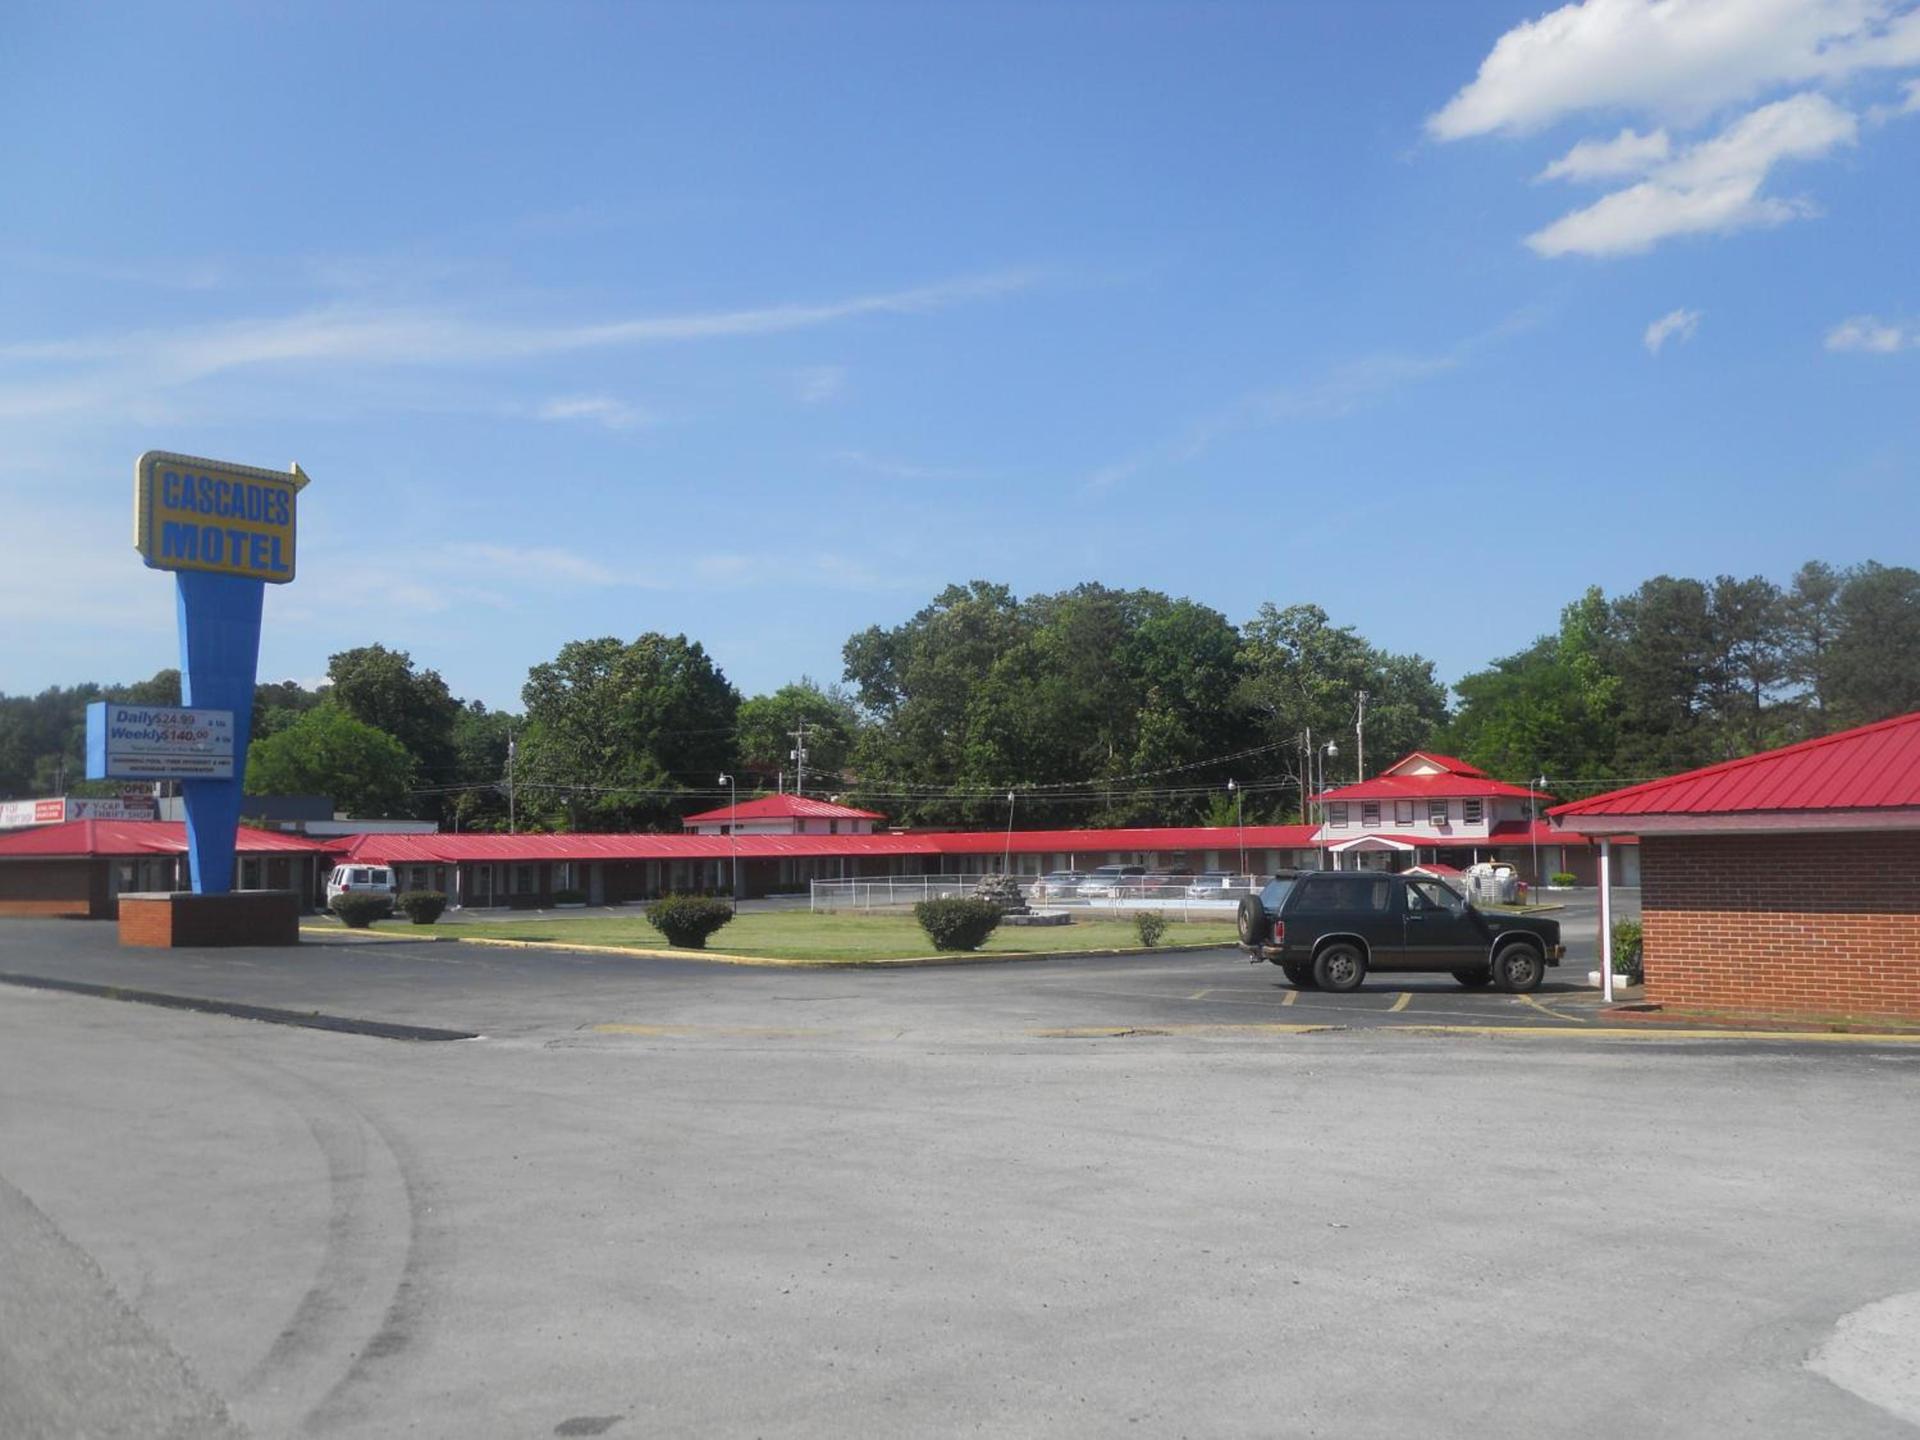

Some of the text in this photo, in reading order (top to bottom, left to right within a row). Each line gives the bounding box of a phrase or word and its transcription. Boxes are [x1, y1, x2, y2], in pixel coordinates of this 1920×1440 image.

[162, 470, 290, 527] CASCADES
[162, 521, 289, 573] MOTEL
[111, 727, 161, 743] Weekly
[116, 710, 154, 726] Daily
